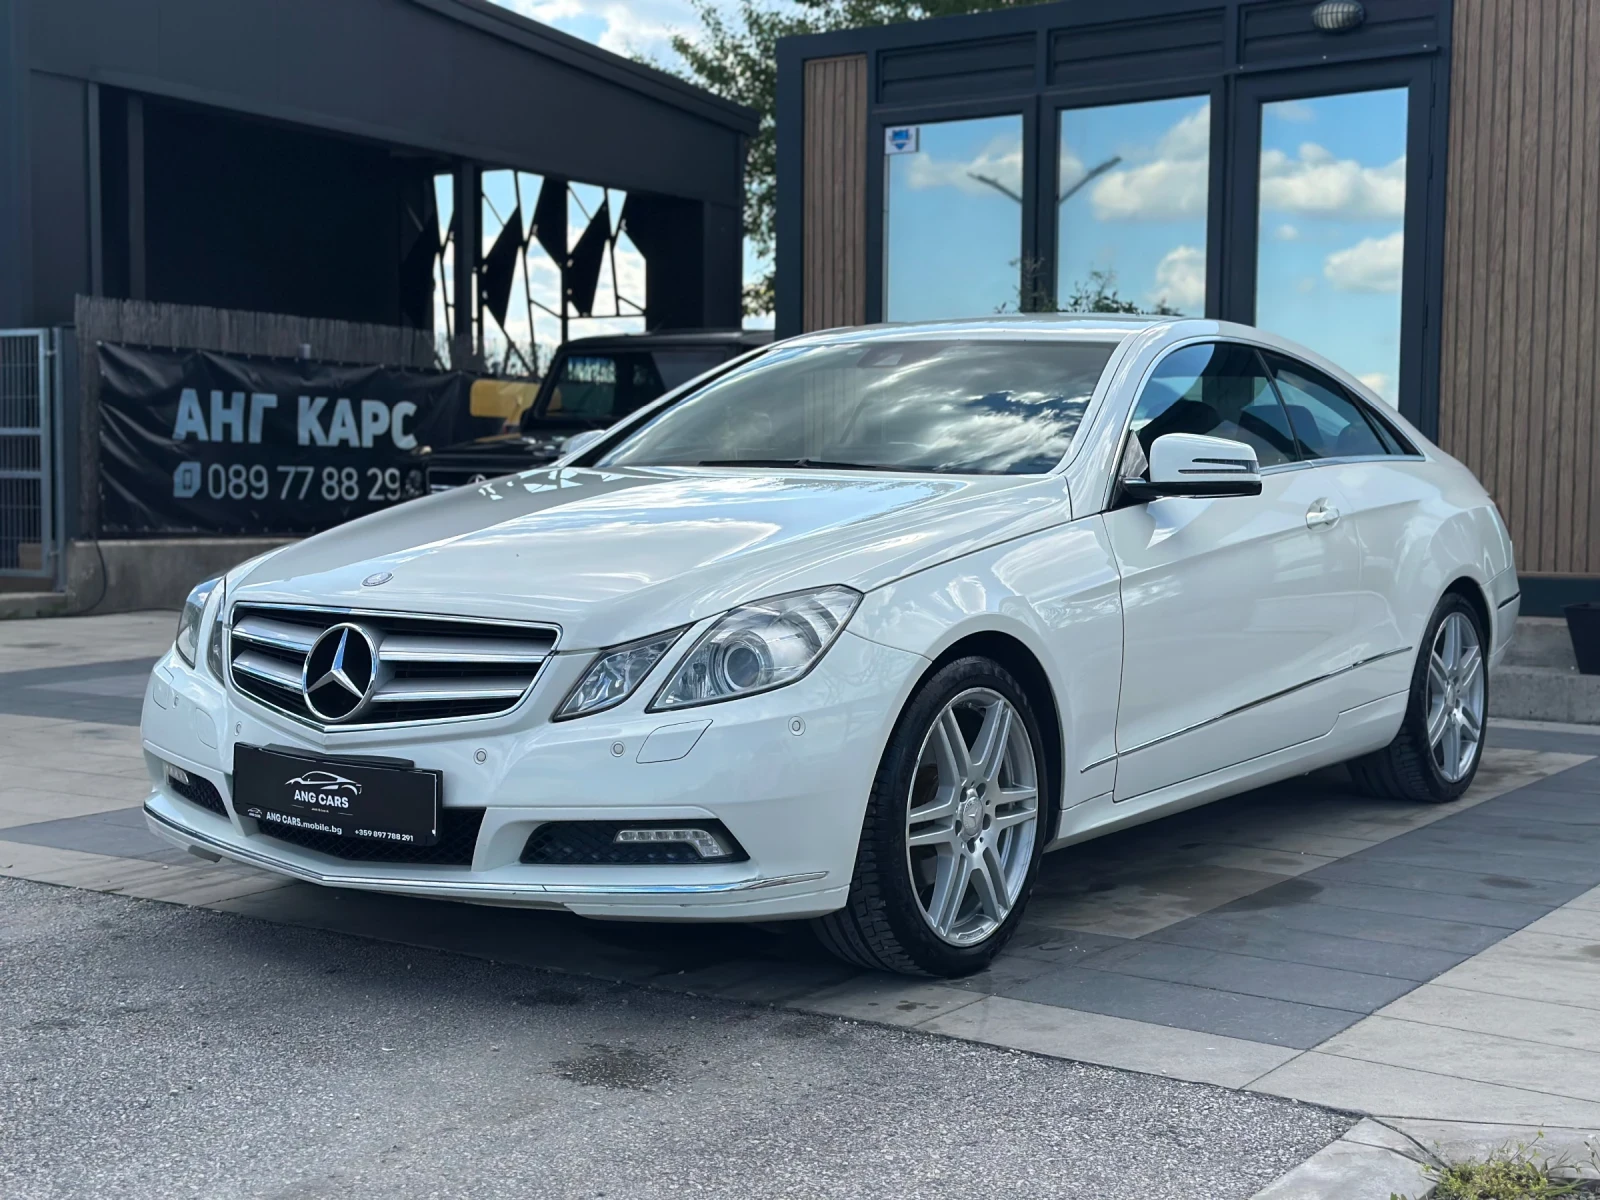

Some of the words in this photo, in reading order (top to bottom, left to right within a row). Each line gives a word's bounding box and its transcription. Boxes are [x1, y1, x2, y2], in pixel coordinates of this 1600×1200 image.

[172, 388, 278, 444] АНГ
[297, 396, 419, 450] КАРС
[207, 463, 269, 501] 089
[277, 465, 315, 501] 77
[321, 466, 359, 502] 88
[366, 467, 401, 502] 29
[294, 789, 316, 804] ANG
[318, 794, 349, 809] CARS
[266, 811, 281, 822] ANG
[282, 815, 343, 835] CARS.mobile.bg
[354, 829, 372, 837] +359
[387, 832, 401, 840] 788
[401, 834, 414, 842] 291
